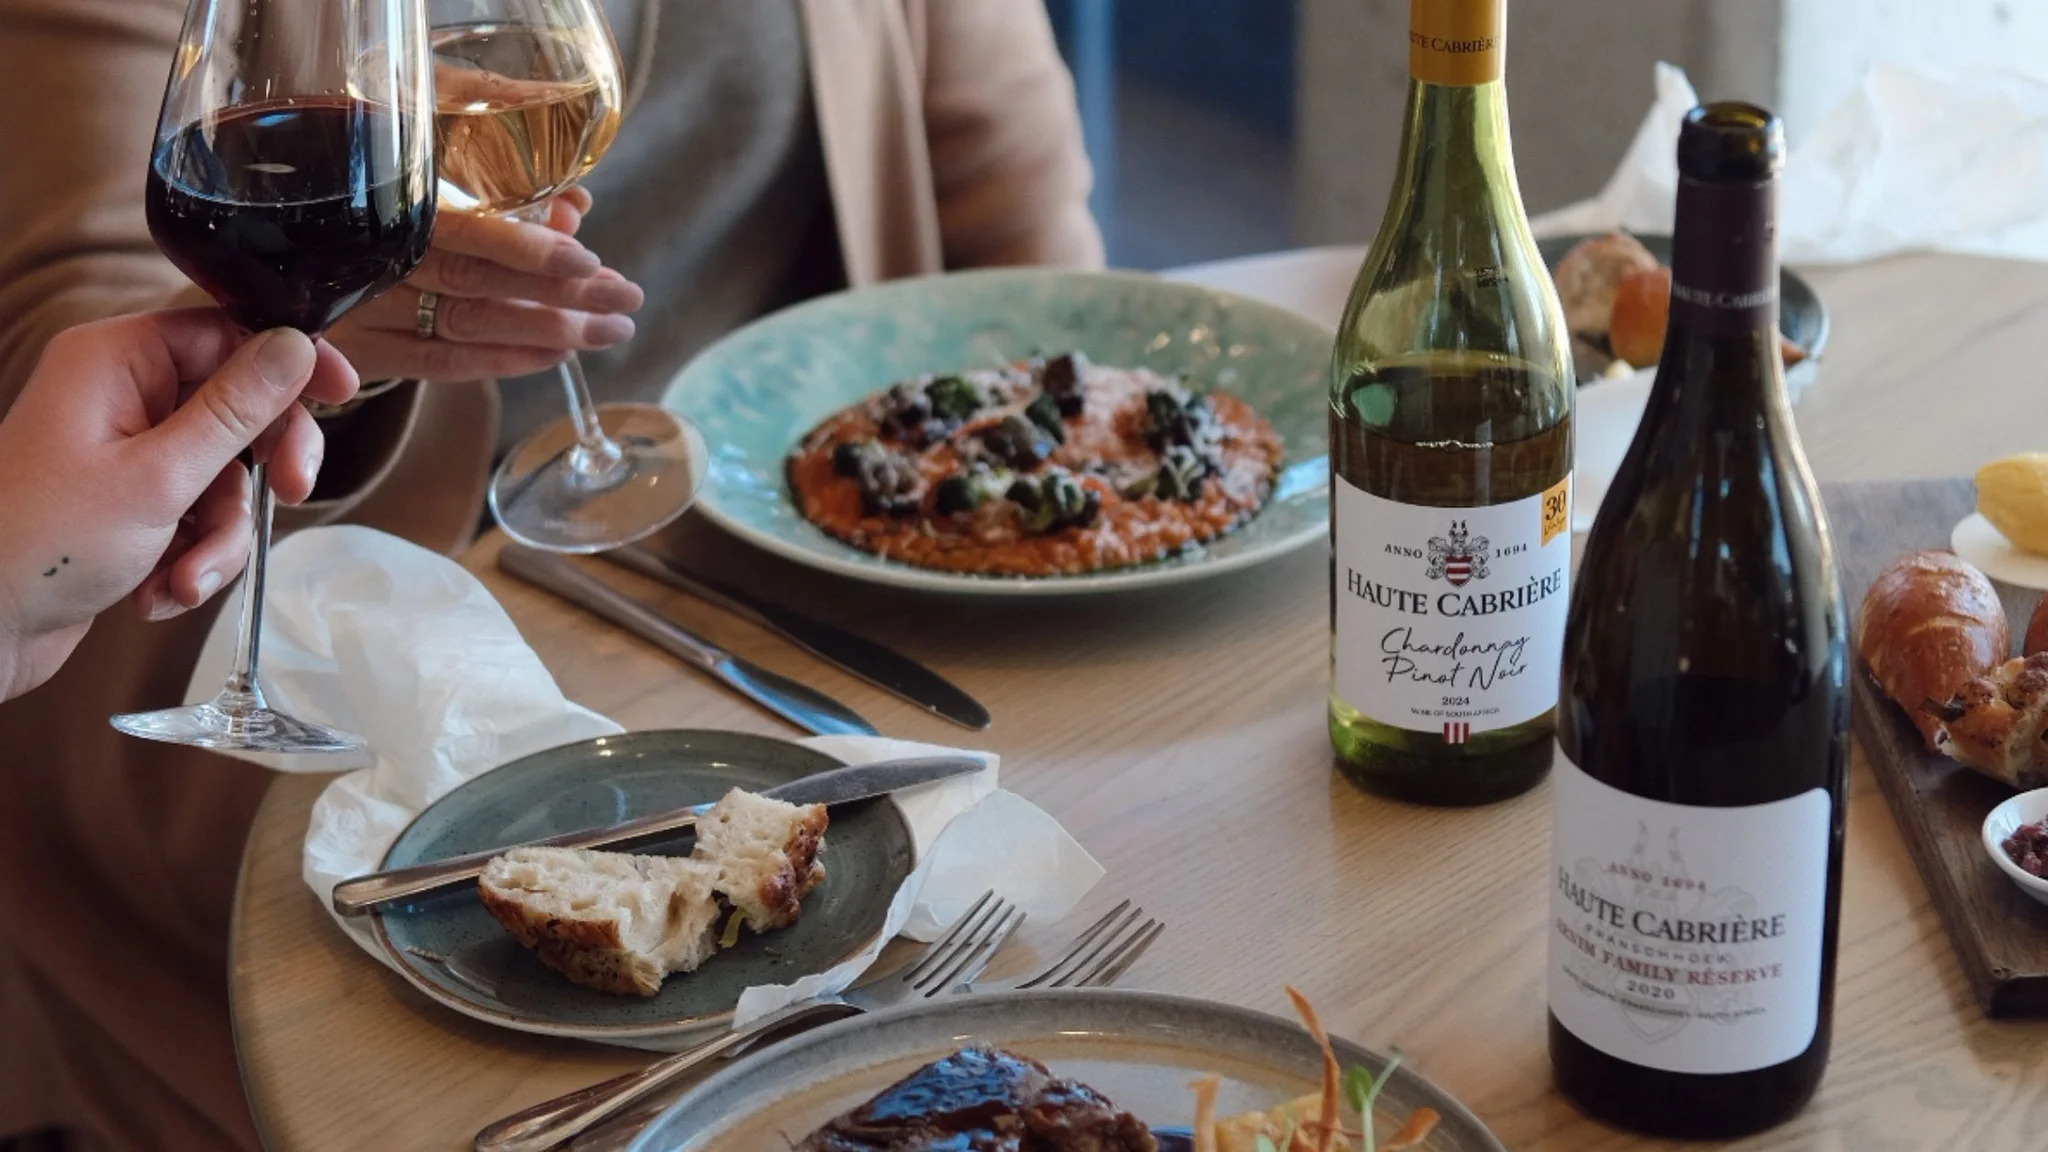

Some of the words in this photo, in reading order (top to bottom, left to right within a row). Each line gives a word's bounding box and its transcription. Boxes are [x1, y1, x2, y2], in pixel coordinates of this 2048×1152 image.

[1546, 490, 1566, 520] 30
[1384, 543, 1423, 559] ANNO
[1495, 543, 1527, 558] 1694
[1347, 566, 1428, 616] HAUTE
[1437, 568, 1561, 617] CABRIÈRE
[1381, 626, 1531, 667] Chardonnay
[1381, 655, 1465, 687] Pinot
[1468, 660, 1527, 691] Noir
[1441, 696, 1470, 706] 2024
[1608, 861, 1653, 883] ANNO
[1661, 876, 1707, 892] 1694
[1558, 866, 1624, 929] HAUTE
[1633, 910, 1787, 944] CABRIÈRE
[1602, 951, 1679, 983] FAMILY
[1687, 962, 1783, 986] RÉSERVE
[1626, 979, 1676, 1000] 2020
